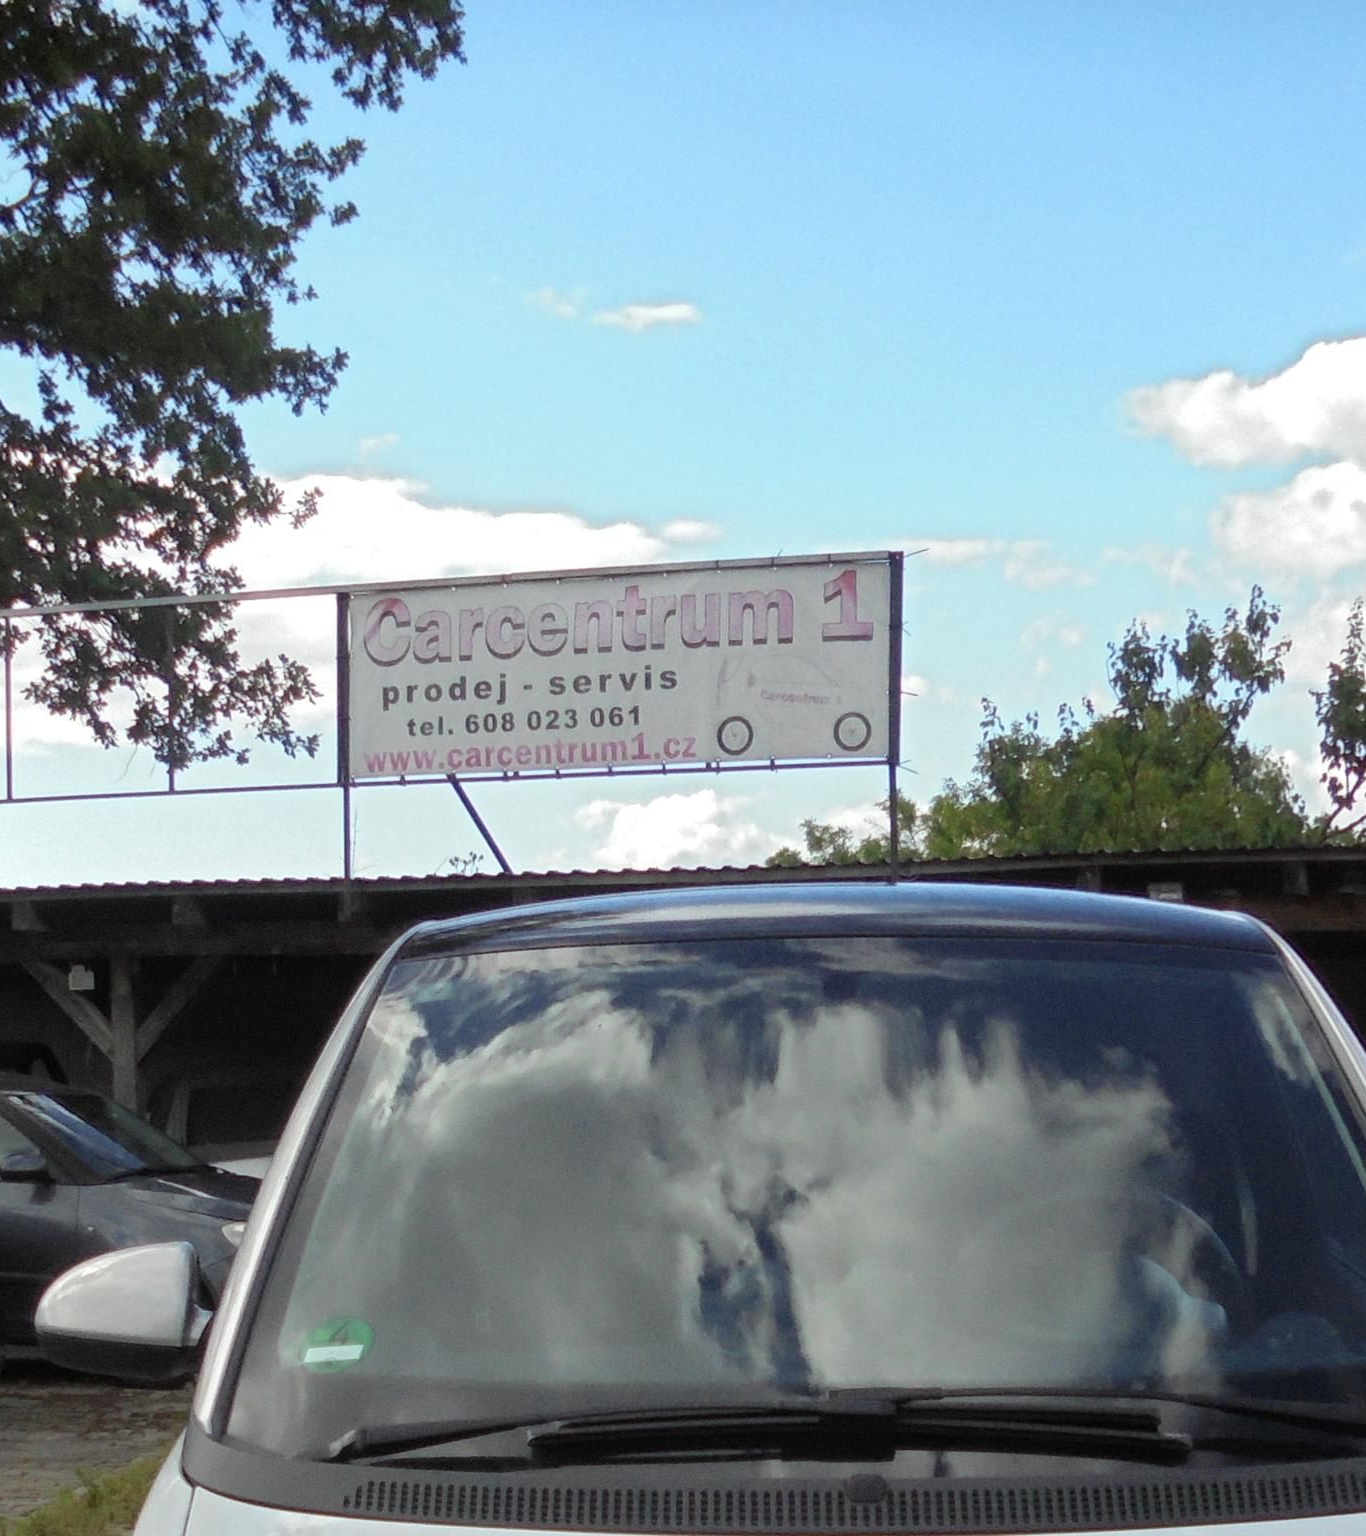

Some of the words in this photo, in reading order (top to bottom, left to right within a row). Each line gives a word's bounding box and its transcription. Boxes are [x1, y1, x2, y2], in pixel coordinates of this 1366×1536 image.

[364, 585, 794, 666] Carcentrum
[822, 569, 874, 642] 1
[382, 673, 507, 711] prodej
[548, 665, 678, 695] servis
[407, 716, 454, 737] tel.
[465, 712, 515, 734] 608
[527, 709, 579, 731] 023
[590, 705, 641, 728] 061
[363, 732, 697, 773] www.carcentrum1.cz
